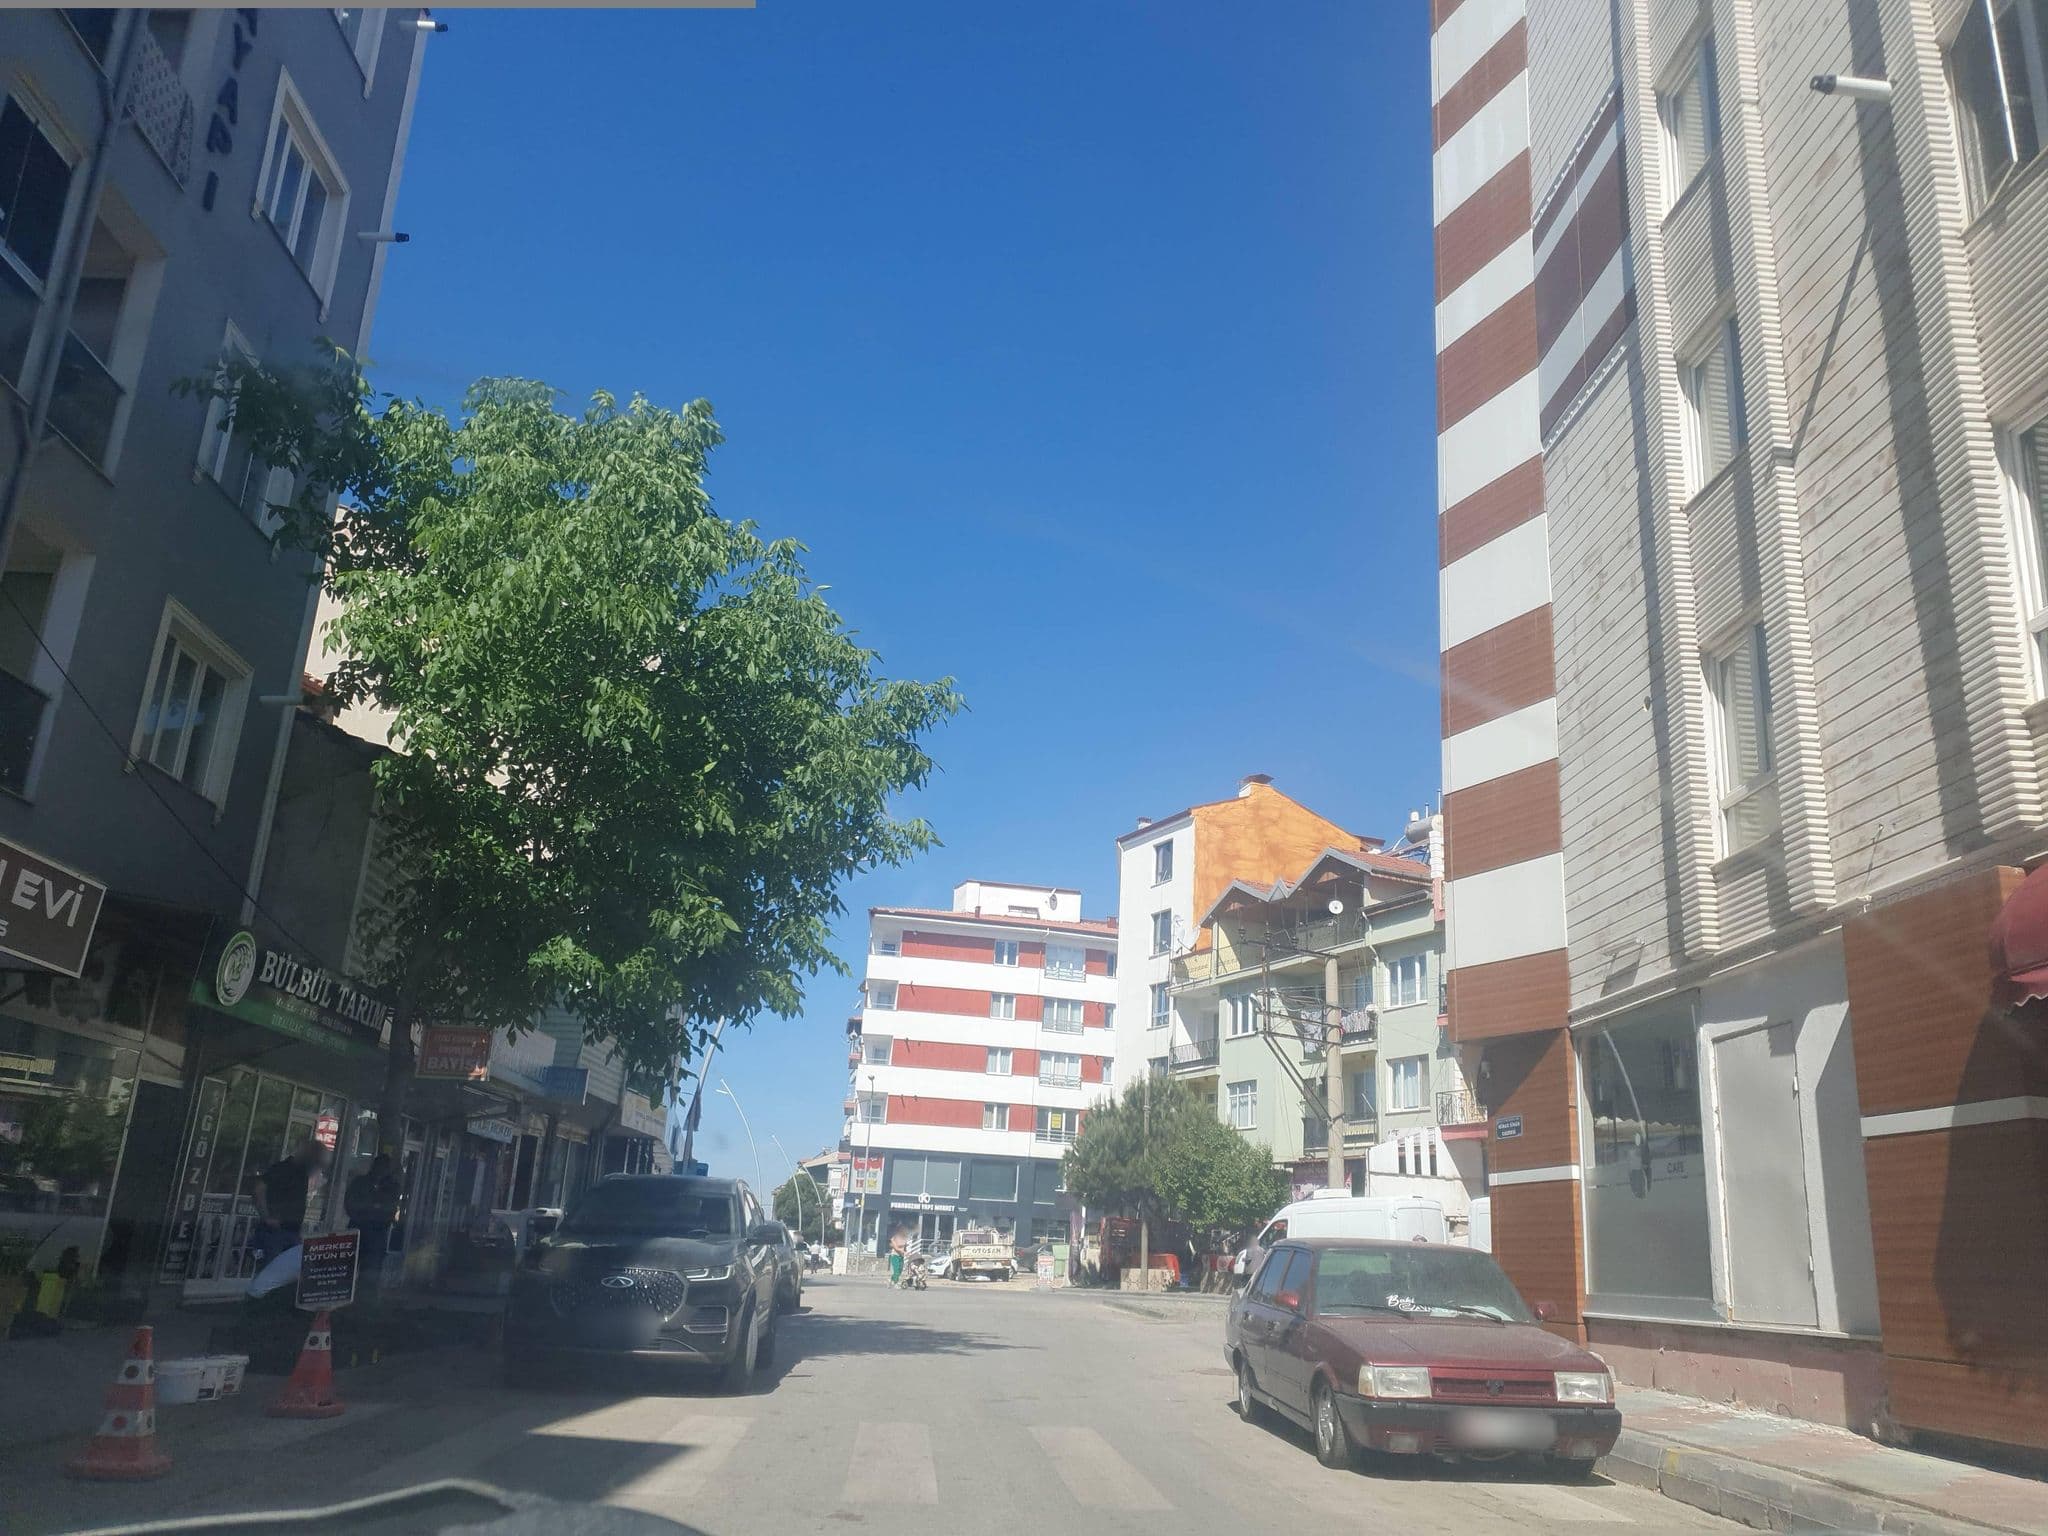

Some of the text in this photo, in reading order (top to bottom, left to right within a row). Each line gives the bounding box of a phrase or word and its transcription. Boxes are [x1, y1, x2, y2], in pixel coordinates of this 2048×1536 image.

[11, 868, 84, 927] EVİ
[259, 950, 333, 1008] BÜLBÜL
[336, 983, 388, 1031] TARIM
[178, 1114, 213, 1238] GÖZDE
[303, 1251, 338, 1261] TÜTÜN
[309, 1242, 352, 1252] MERKEZ
